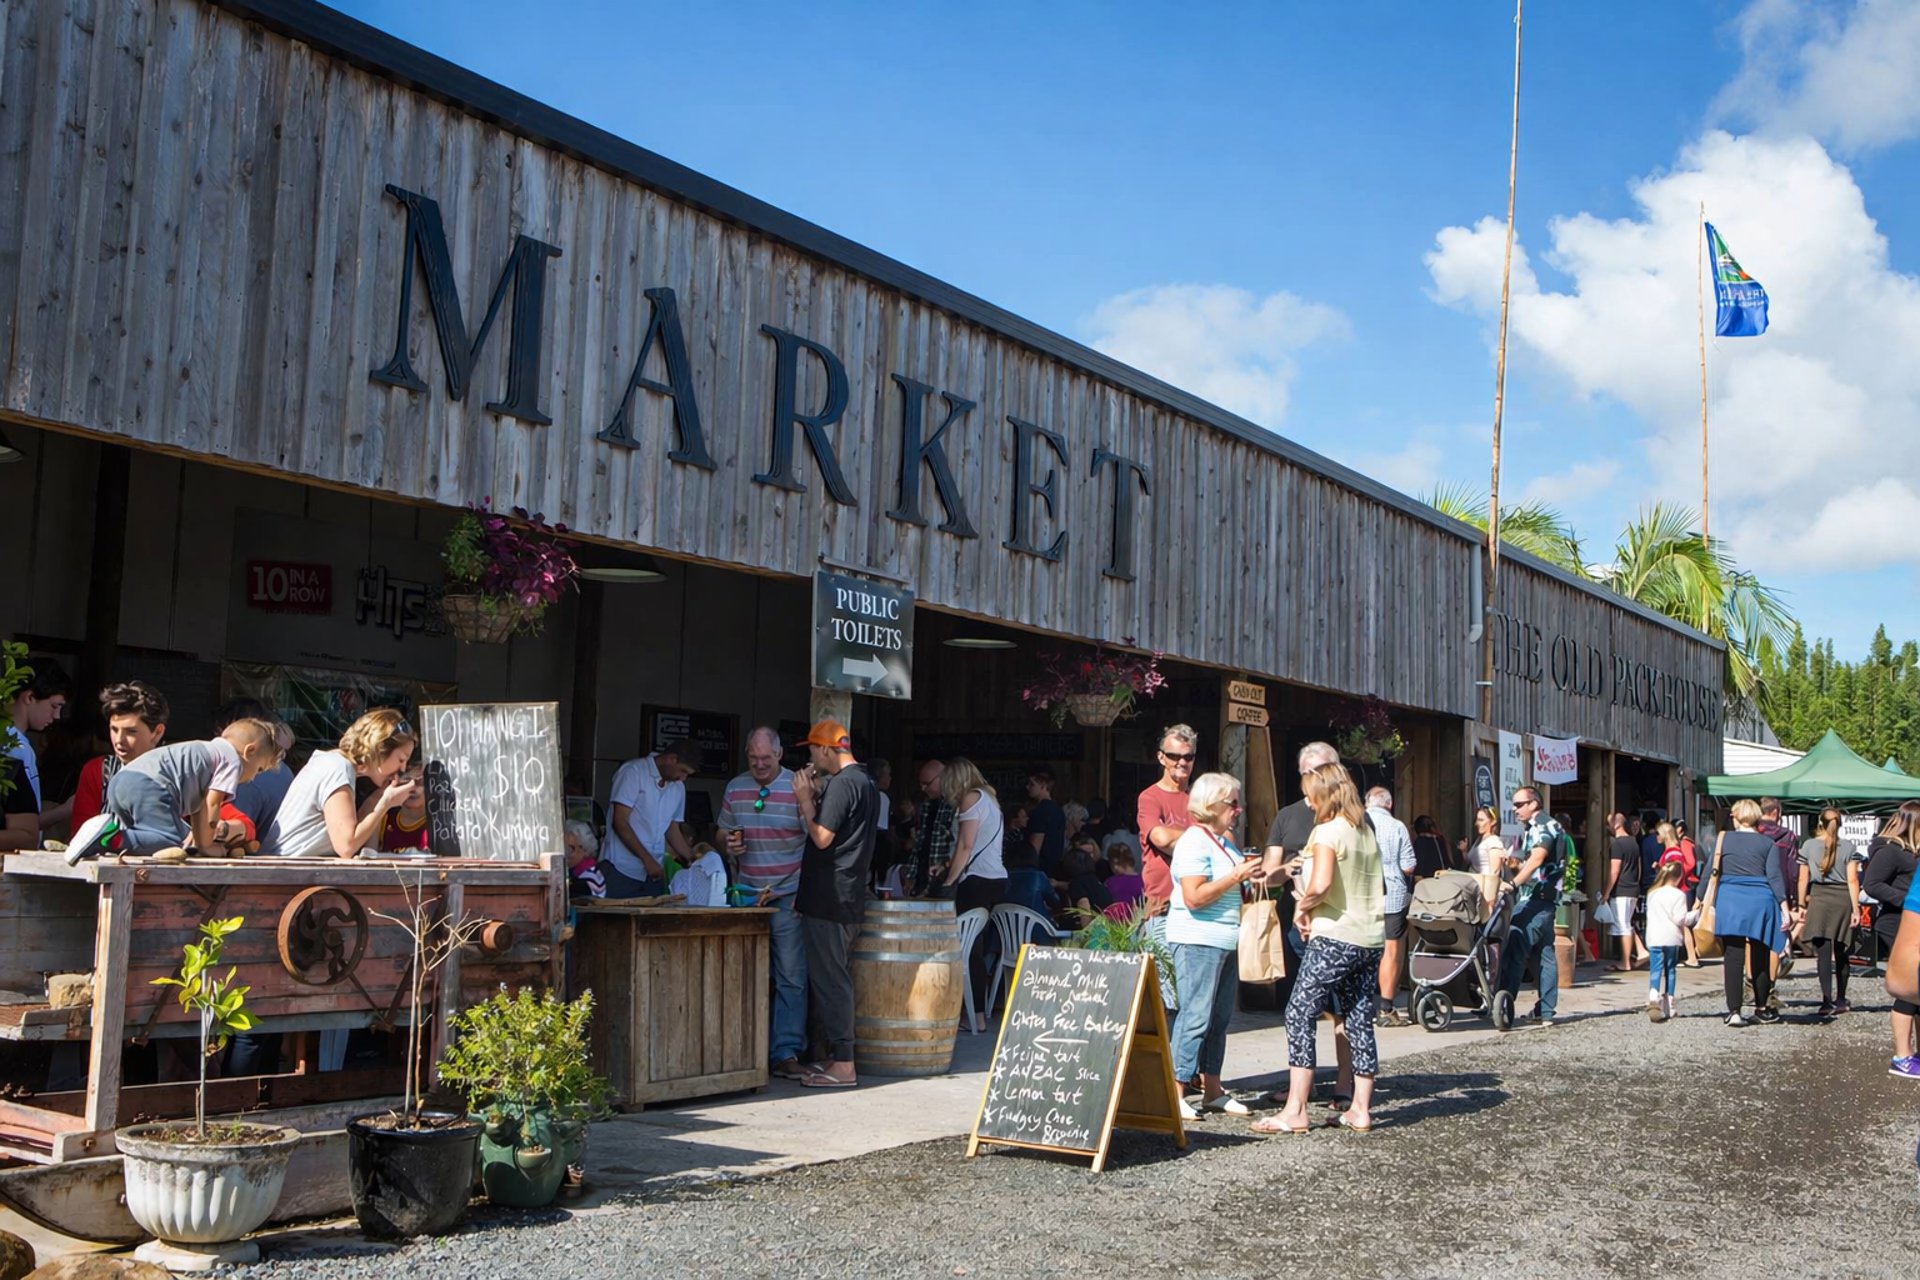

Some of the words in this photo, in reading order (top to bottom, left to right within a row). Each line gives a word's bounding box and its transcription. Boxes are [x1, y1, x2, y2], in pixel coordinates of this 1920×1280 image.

[370, 183, 1152, 582] MARKET
[252, 565, 289, 602] 10
[289, 568, 305, 584] IN
[308, 570, 319, 585] A
[289, 587, 326, 603] ROW
[836, 588, 900, 620] PUBLIC
[831, 617, 902, 650] TOILETS
[1493, 613, 1543, 683] THE
[1551, 634, 1603, 700] OLD
[1610, 652, 1719, 734] PACKHOUSE
[423, 706, 469, 749] HOT
[491, 753, 545, 802] $10
[1004, 1080, 1045, 1100] Lemon
